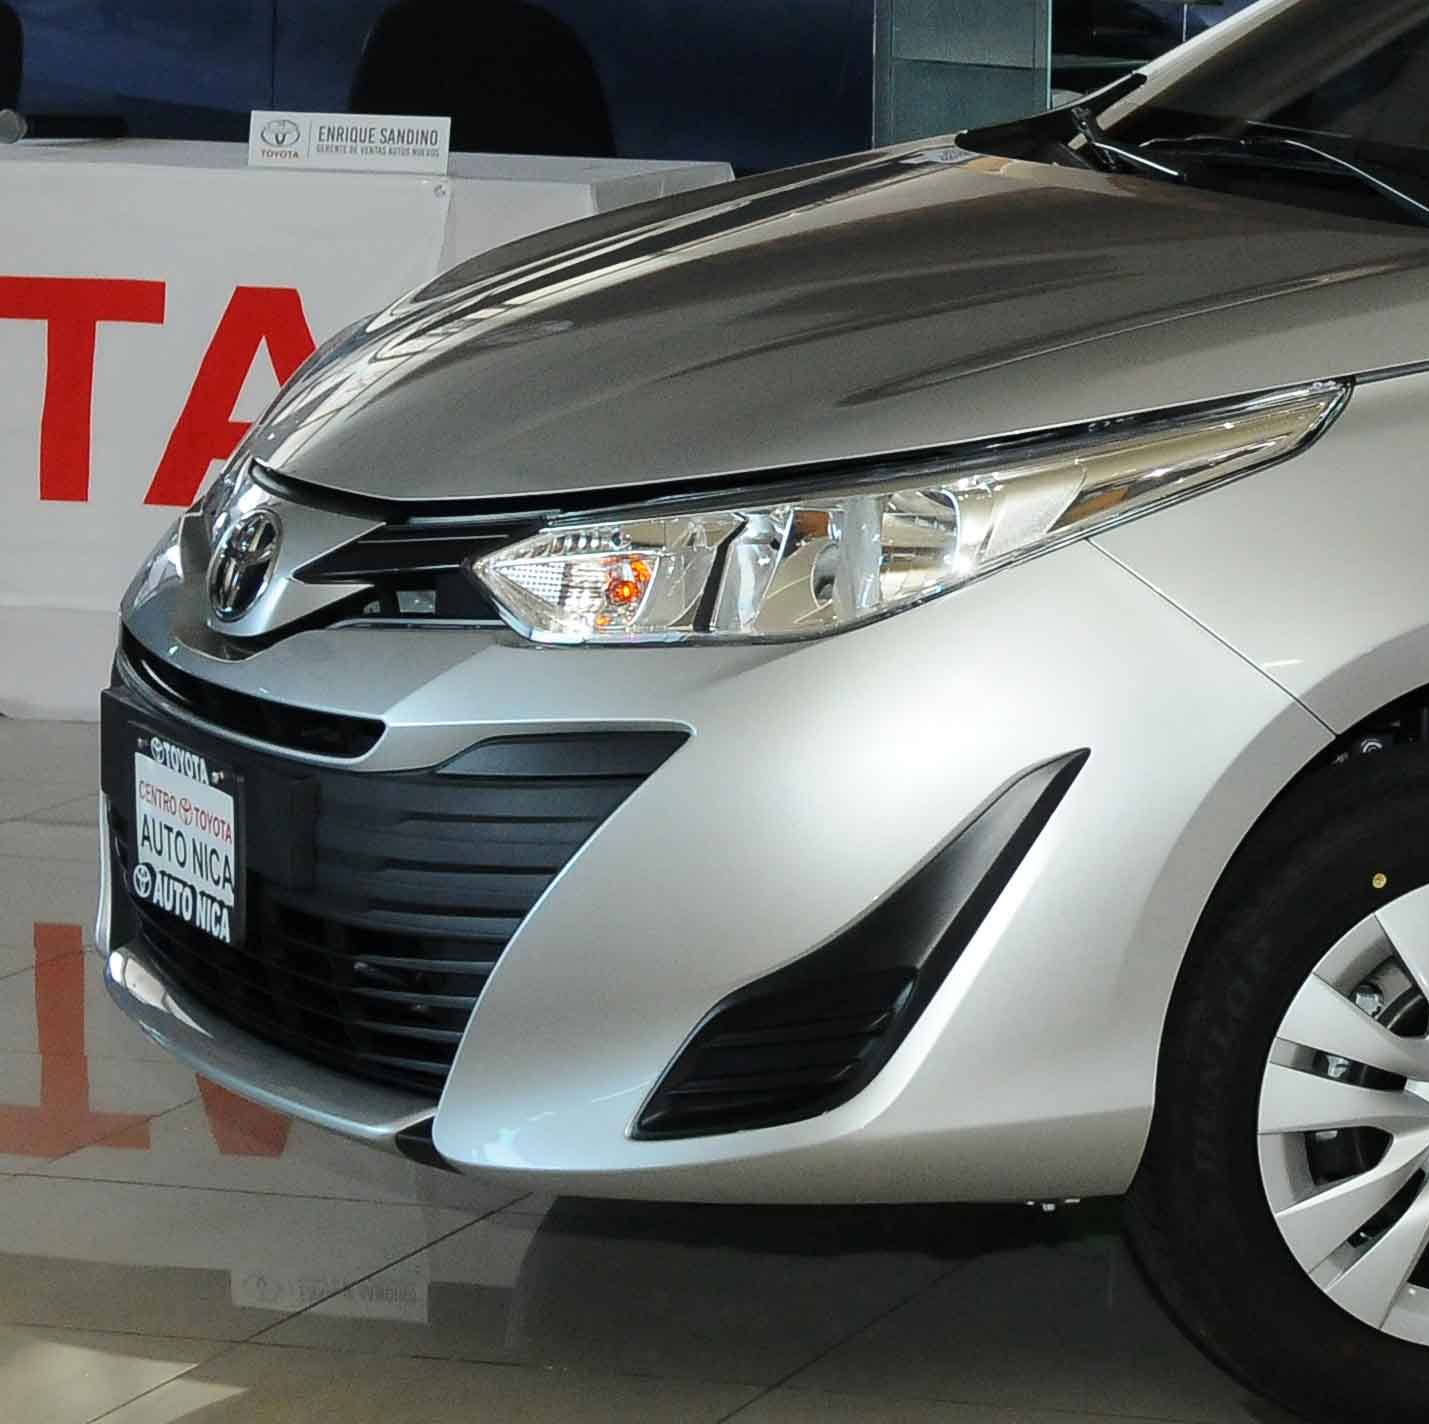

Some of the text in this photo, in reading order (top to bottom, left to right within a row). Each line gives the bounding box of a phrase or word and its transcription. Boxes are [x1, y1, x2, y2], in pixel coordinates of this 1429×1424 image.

[261, 149, 299, 160] TOYOTA
[318, 125, 439, 147] ENRIQUE SANDINO
[163, 741, 209, 785] TOYOTA
[139, 780, 233, 845] CENTRO TOYOTA
[141, 812, 235, 890] AUTO NICA
[152, 870, 231, 944] AUTO NICA
